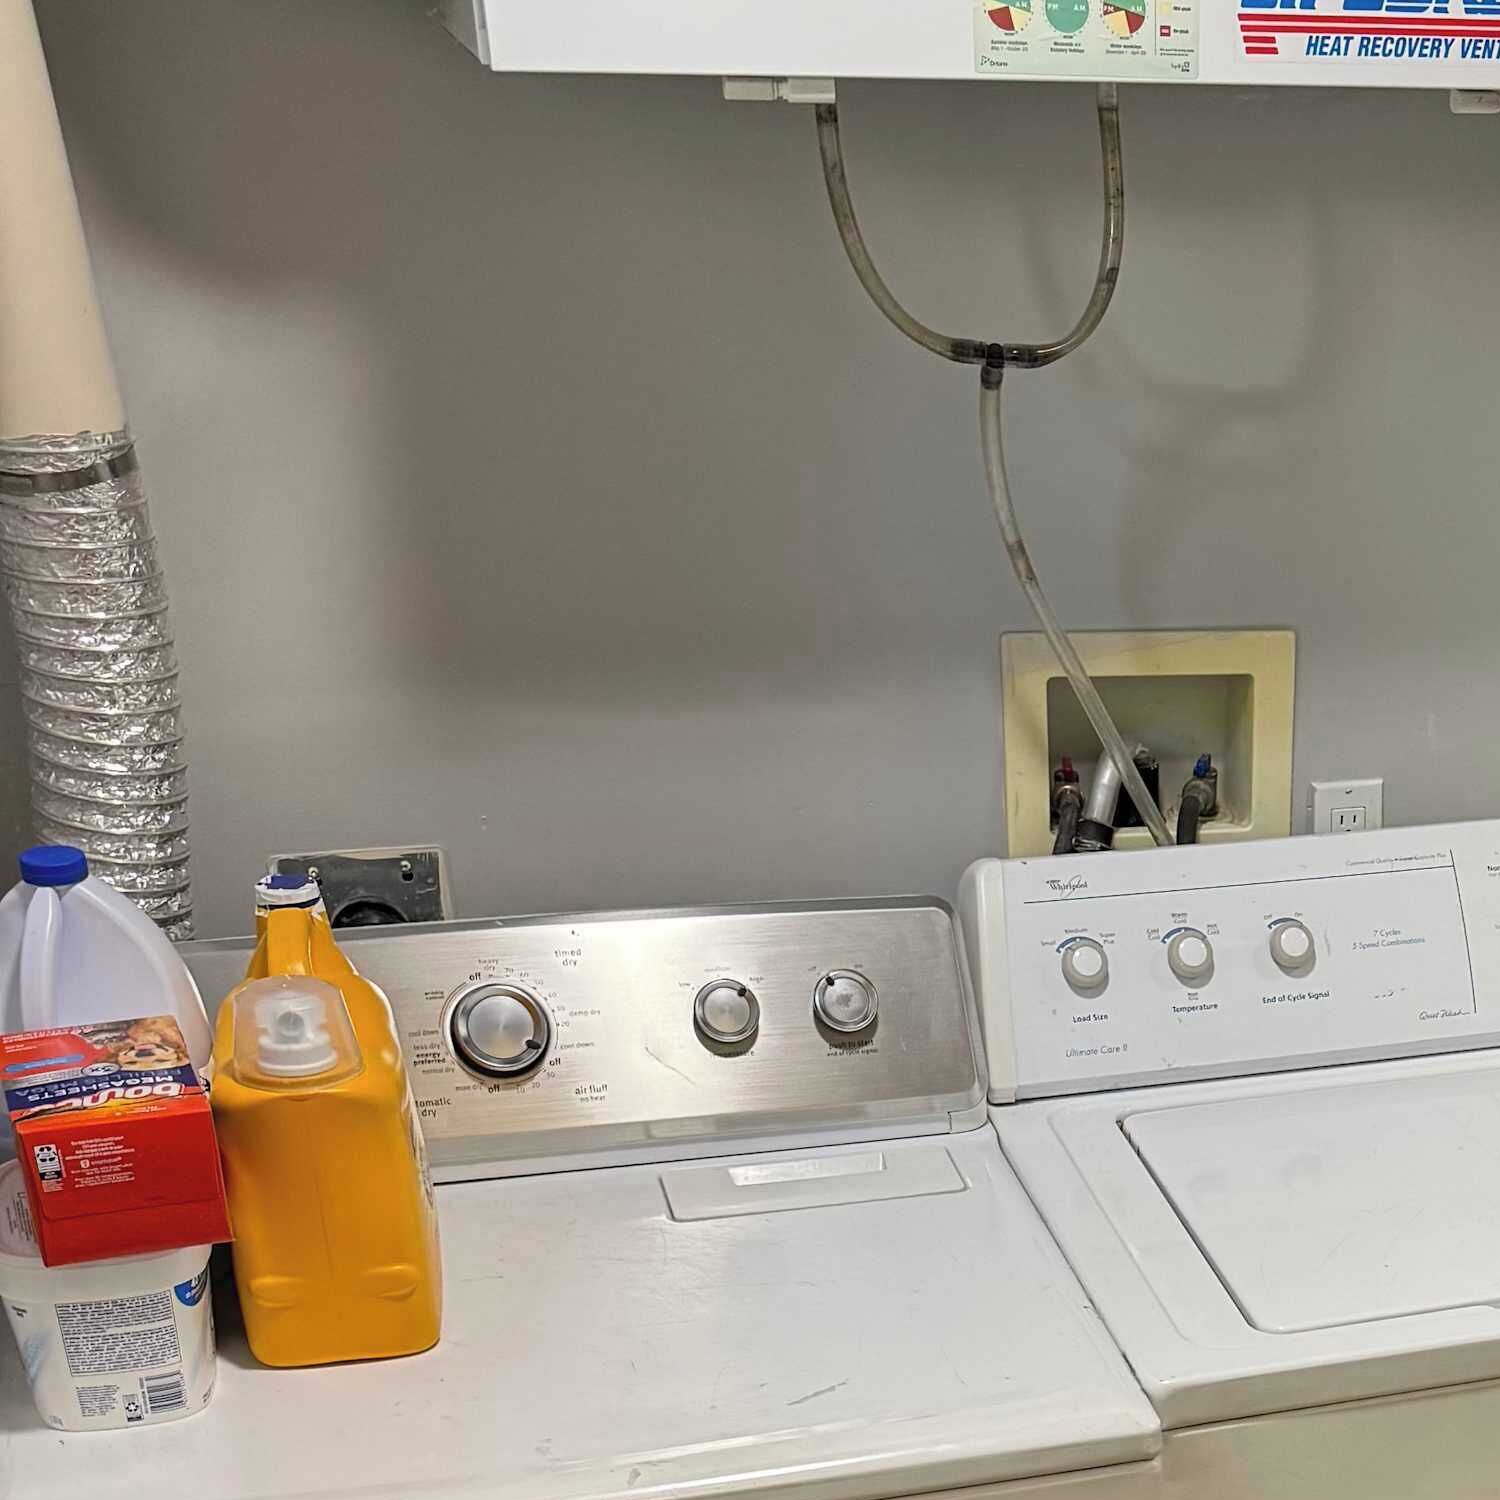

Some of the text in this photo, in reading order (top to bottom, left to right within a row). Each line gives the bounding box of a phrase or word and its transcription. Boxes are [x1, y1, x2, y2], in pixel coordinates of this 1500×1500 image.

[1305, 35, 1354, 57] HEAT
[1357, 36, 1455, 58] RECOVERY
[1046, 876, 1088, 892] Whirlpool
[1379, 928, 1401, 937] Cycles
[1359, 941, 1379, 950] Speed
[1381, 938, 1426, 948] Combinations
[554, 949, 582, 957] timed
[562, 959, 578, 968] dry
[468, 972, 481, 981] off
[1263, 996, 1277, 1004] End
[1287, 994, 1306, 1003] Cycle
[1307, 990, 1330, 1000] Signal
[1172, 1003, 1219, 1013] Temperature
[1072, 1013, 1109, 1023] Load Size
[1065, 1047, 1098, 1058] Ultimate
[1100, 1045, 1121, 1054] Care
[413, 1058, 446, 1067] preferred
[549, 1057, 561, 1066] off
[28, 1076, 174, 1102] MEGASHEETS
[488, 1084, 500, 1094] off
[575, 1084, 608, 1095] air fluff
[415, 1097, 452, 1108] tomatic
[421, 1108, 437, 1118] dry
